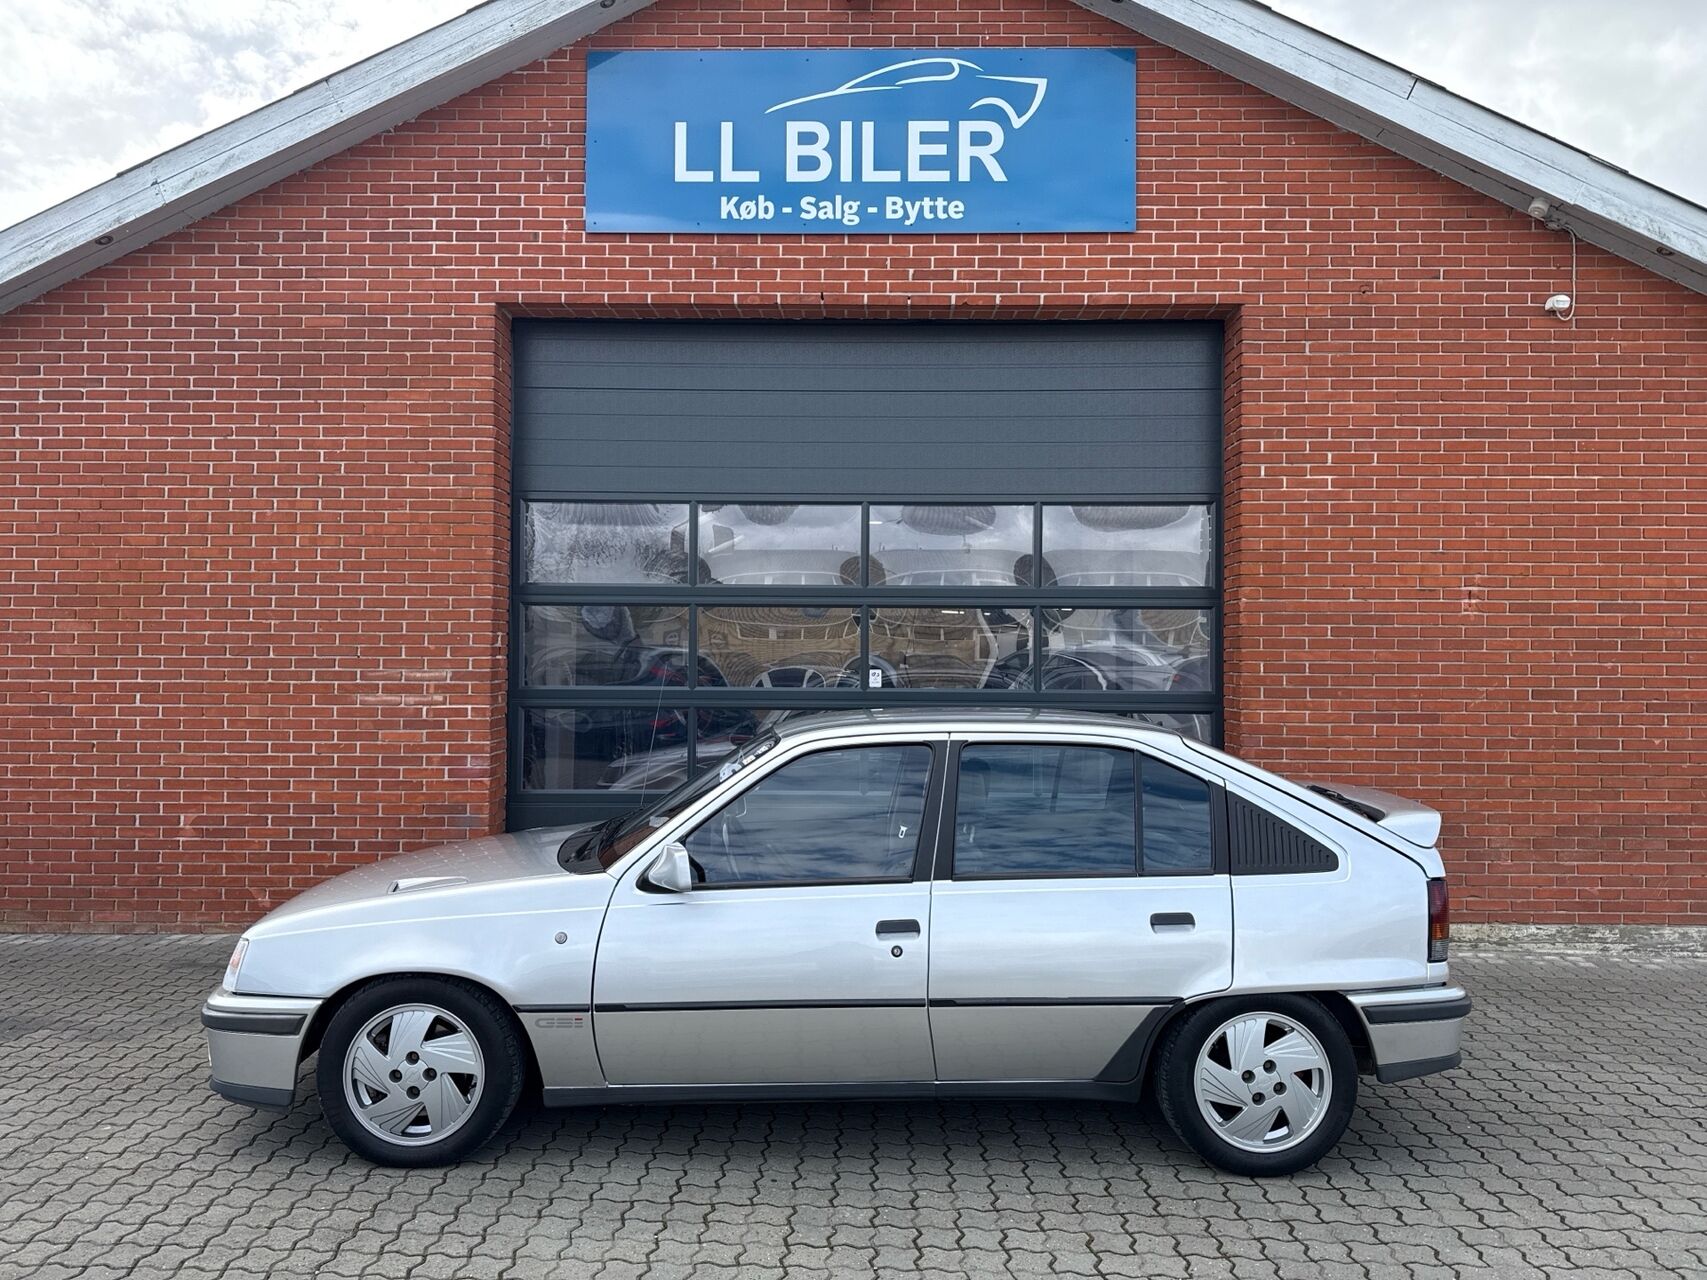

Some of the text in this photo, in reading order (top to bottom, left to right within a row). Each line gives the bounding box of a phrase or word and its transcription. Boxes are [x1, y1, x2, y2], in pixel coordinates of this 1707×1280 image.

[674, 120, 1008, 182] LL BILER
[720, 195, 775, 221] Køb
[800, 195, 861, 225] Salg
[885, 197, 965, 225] Bytte
